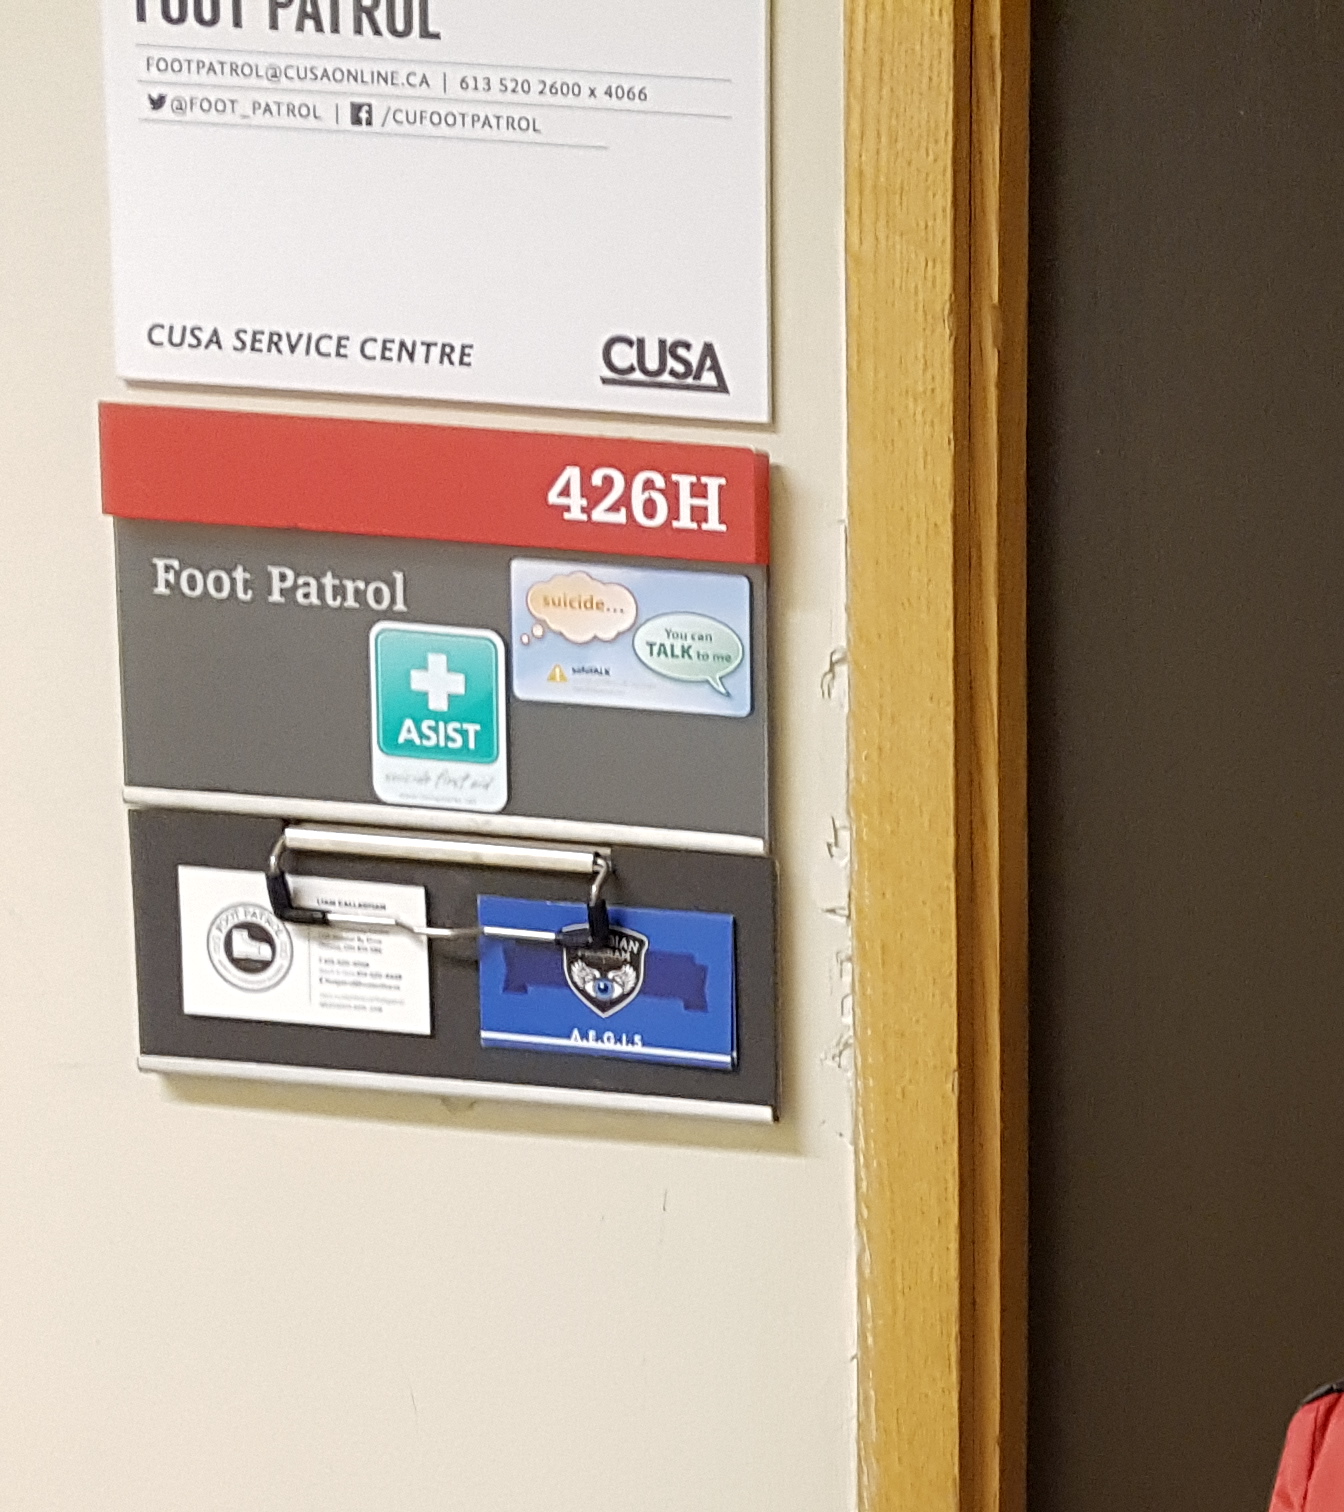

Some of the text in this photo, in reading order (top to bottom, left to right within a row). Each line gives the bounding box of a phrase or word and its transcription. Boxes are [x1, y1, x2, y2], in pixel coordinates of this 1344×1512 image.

[145, 56, 649, 102] FOOTPATROL@CUSAONLINE.CA 613 520 2600 x 4066
[169, 97, 542, 134] @FOOT_PATROL /CUFOOTPATROL
[147, 323, 475, 367] CUSA SERVICE CENTRE
[601, 335, 730, 395] CUSA
[547, 465, 727, 533] 426H
[152, 557, 408, 613] Foot Patrol
[646, 641, 732, 663] TALK to me
[664, 627, 713, 642] You can
[397, 717, 482, 751] ASIST
